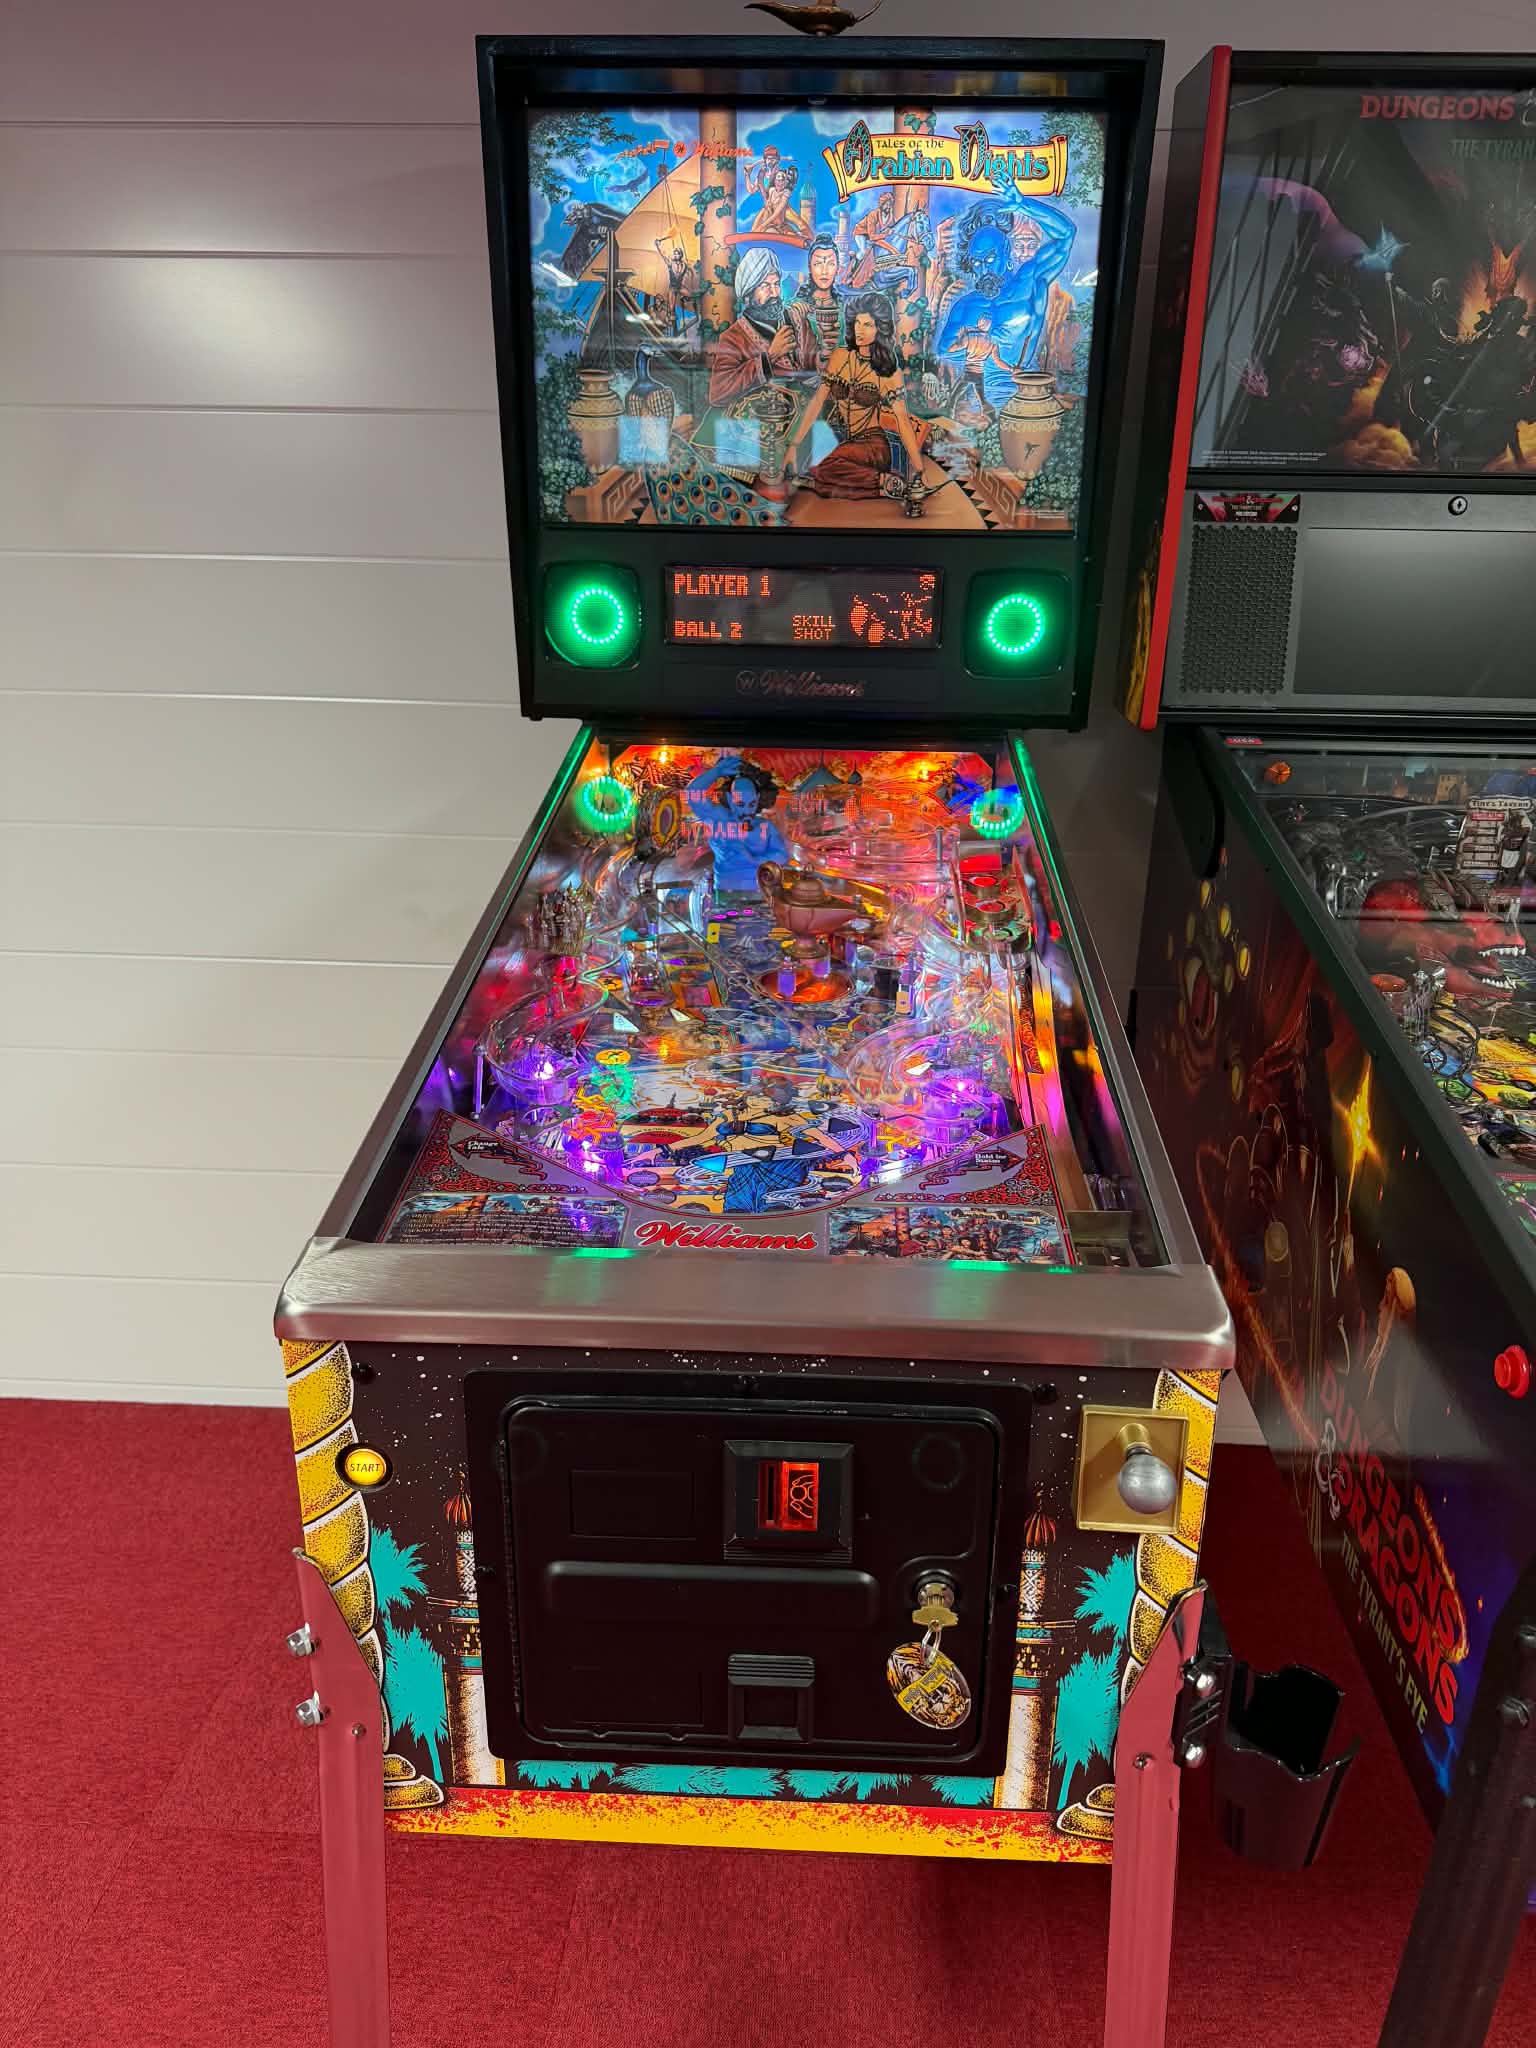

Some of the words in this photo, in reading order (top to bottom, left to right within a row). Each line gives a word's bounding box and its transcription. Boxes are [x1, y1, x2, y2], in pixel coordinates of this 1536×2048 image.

[1360, 95, 1516, 120] DUNGEONS
[688, 140, 754, 160] Williams
[843, 120, 955, 182] Arabian
[954, 120, 1050, 181] Nights
[876, 139, 906, 149] TALES
[908, 139, 925, 149] OF
[1448, 138, 1481, 161] THE
[674, 574, 748, 596] PLAYER
[760, 575, 771, 596] 1
[674, 620, 722, 639] BALL
[728, 622, 743, 639] 2
[792, 615, 836, 627] SKILL
[794, 628, 832, 640] SHOT
[760, 670, 865, 697] Williams
[634, 1219, 818, 1251] Williams
[350, 1463, 381, 1473] START
[1320, 1360, 1464, 1653] DUNGEONS
[1334, 1450, 1459, 1726] DRAGONS
[1341, 1530, 1359, 1585] THE
[1359, 1573, 1408, 1685] TYRANT'S
[1402, 1670, 1429, 1735] EYE
